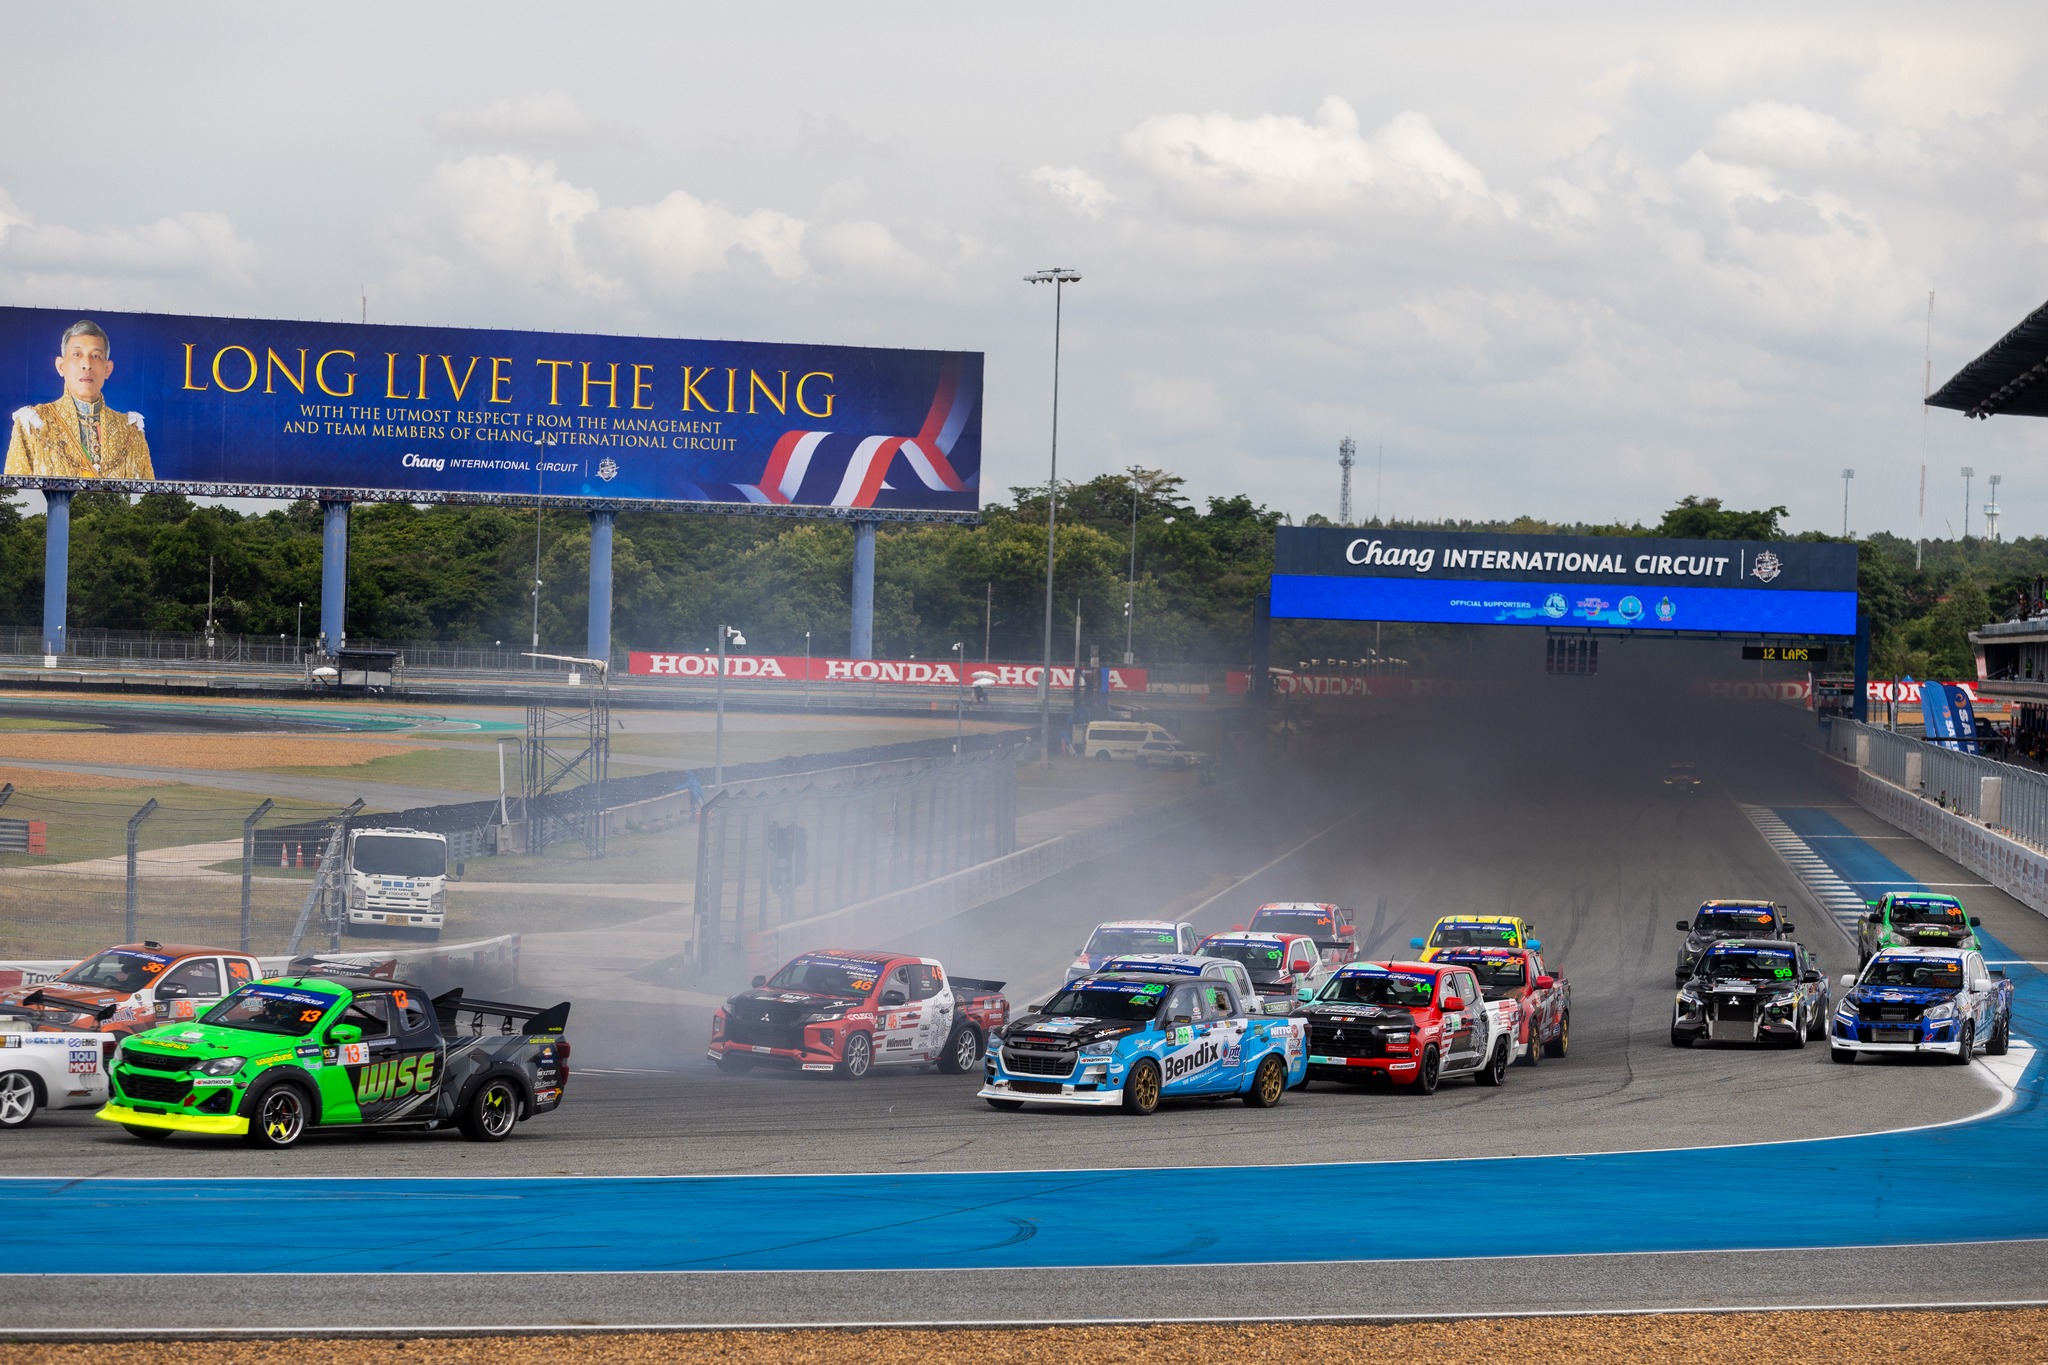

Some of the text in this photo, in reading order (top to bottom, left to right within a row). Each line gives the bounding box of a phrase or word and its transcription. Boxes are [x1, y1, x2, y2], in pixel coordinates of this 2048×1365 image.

[182, 343, 836, 419] LONG LIVE THE KING
[301, 404, 723, 434] WITH THE UTMOST RESPECT FROM THE MANAGEMENT
[284, 420, 738, 451] AND TEAM MEMBERS OF CHANG INTERNATIONAL CIRCUIT
[402, 453, 579, 474] Chang INTERNATIONAL CIRCUIT
[1345, 538, 1436, 572] Chang
[1443, 548, 1628, 578] INTERNATIONAL
[1634, 554, 1730, 577] CIRCUIT
[1762, 648, 1809, 660] 12 LAPS
[649, 654, 786, 677] HONDA
[825, 660, 960, 684] HONDA
[1157, 934, 1175, 944] 39
[1500, 930, 1517, 940] 23
[815, 955, 849, 963] MITSUBISHI
[1266, 949, 1284, 960] 81
[1506, 956, 1525, 965] 45
[141, 962, 166, 974] 36
[228, 961, 249, 980] 36
[857, 966, 877, 974] PICKUP
[931, 966, 943, 980] 46
[1773, 968, 1793, 978] 99
[1947, 963, 1958, 972] 5
[850, 980, 874, 991] 46
[1141, 983, 1165, 995] 88
[1413, 982, 1433, 993] 14
[283, 994, 304, 1002] SUPER
[302, 997, 325, 1006] PICKUP
[392, 989, 409, 1009] 13
[174, 1000, 194, 1018] 36
[300, 1009, 323, 1022] 13
[847, 1012, 874, 1021] CUSCO
[887, 1013, 898, 1029] 46
[1176, 1027, 1190, 1044] 88
[1270, 1025, 1293, 1036] NITTO
[81, 1038, 98, 1047] ENKEI
[69, 1051, 96, 1062] LIQUI
[344, 1044, 361, 1064] 13
[1228, 1045, 1242, 1059] ptt
[69, 1062, 96, 1073] MOLY
[1164, 1041, 1219, 1082] Bendix
[357, 1051, 436, 1106] WISE
[1189, 1066, 1219, 1083] ANNIVERSARY
